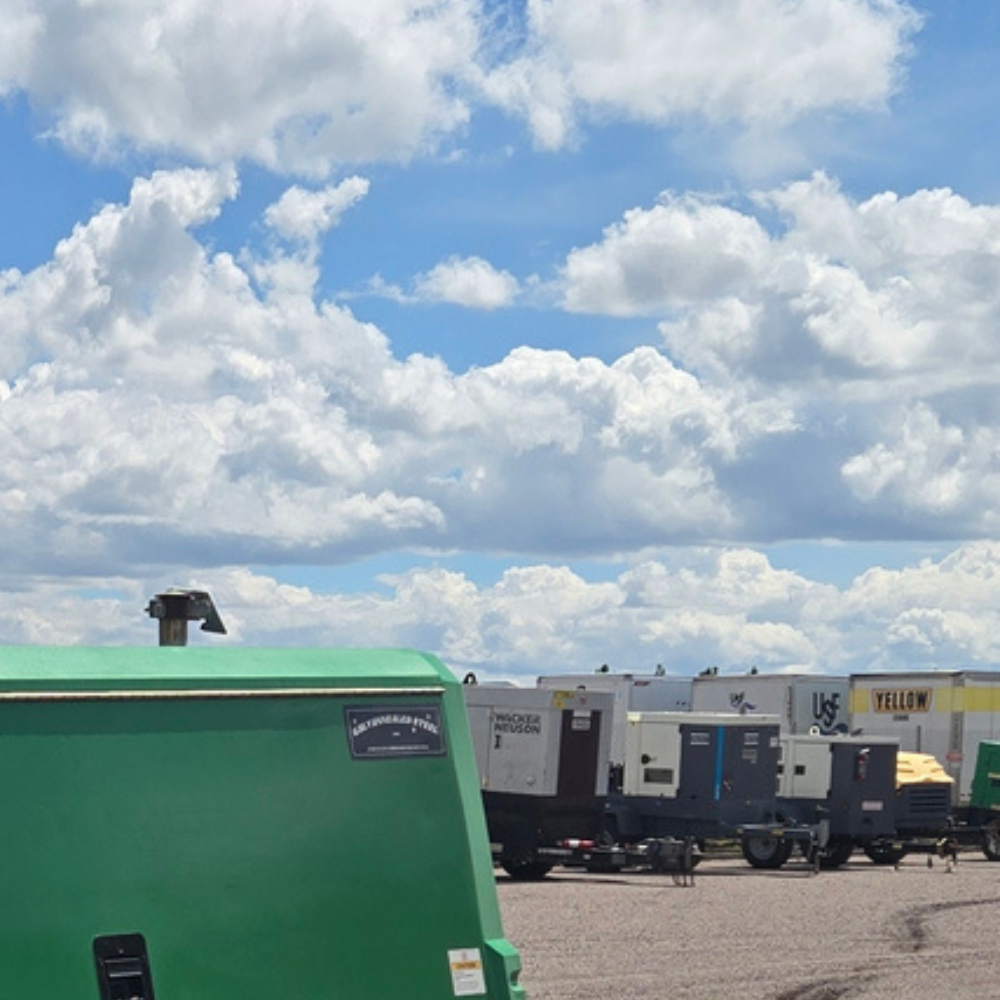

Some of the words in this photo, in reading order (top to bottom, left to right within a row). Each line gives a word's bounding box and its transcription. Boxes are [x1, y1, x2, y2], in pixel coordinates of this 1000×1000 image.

[811, 692, 841, 727] USF
[875, 691, 929, 711] YELLOW
[494, 723, 541, 735] NEUSON
